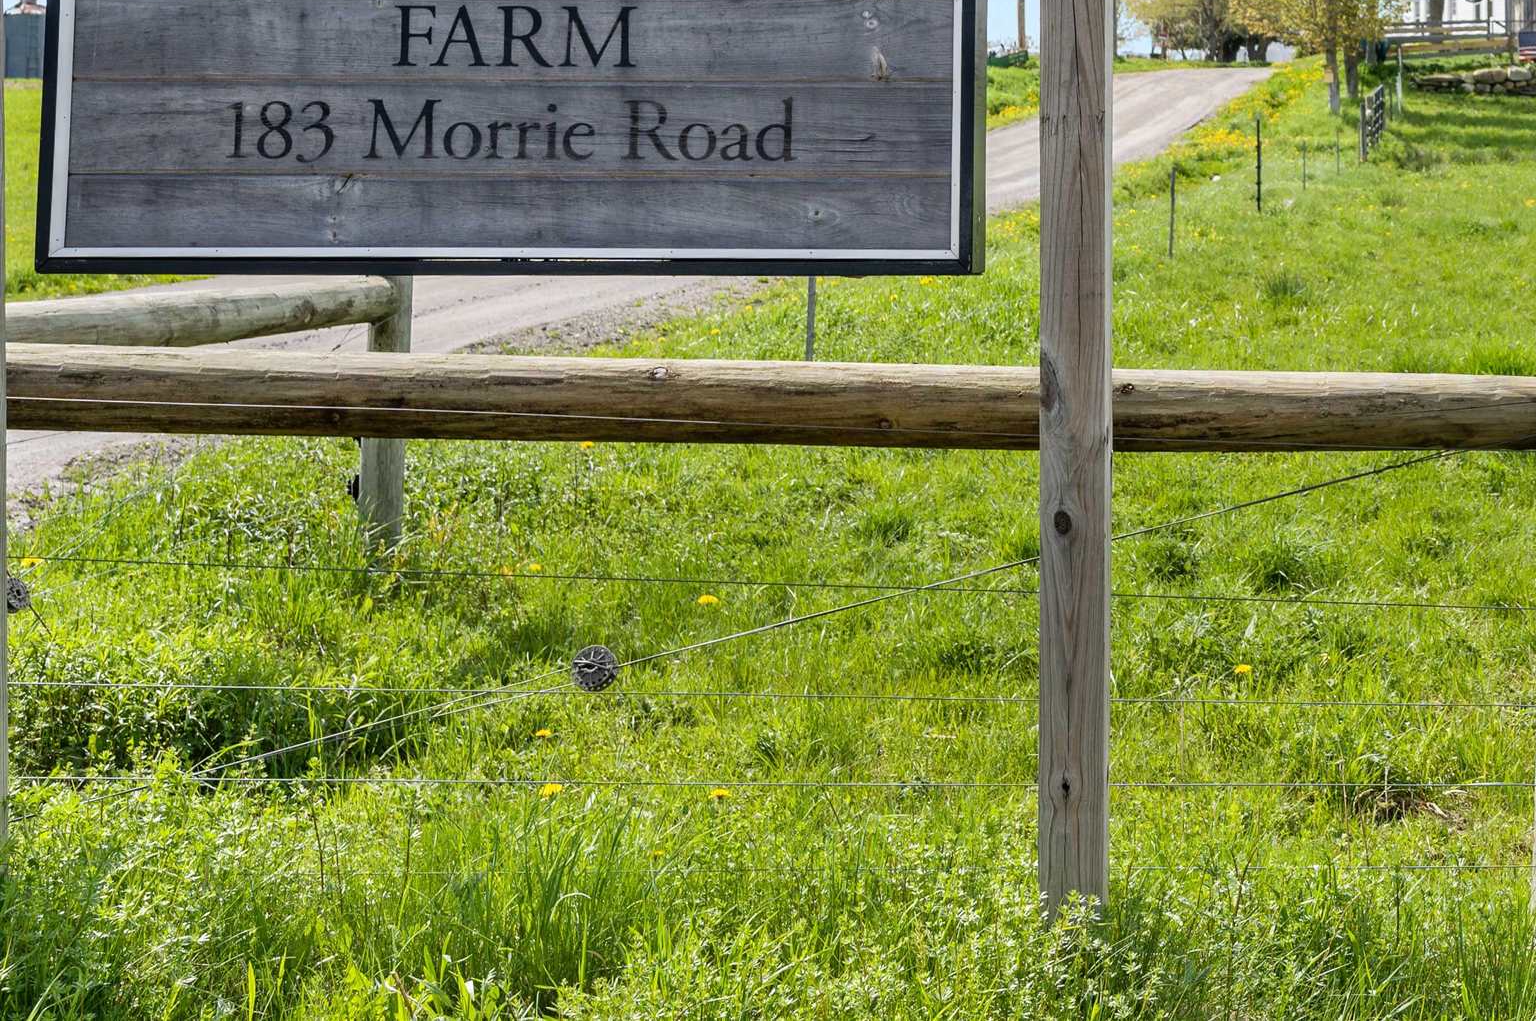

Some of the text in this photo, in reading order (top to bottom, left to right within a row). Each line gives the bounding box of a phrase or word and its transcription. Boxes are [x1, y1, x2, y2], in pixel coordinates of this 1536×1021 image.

[392, 5, 638, 68] FARM
[225, 97, 798, 163] 183 Morrie Road
